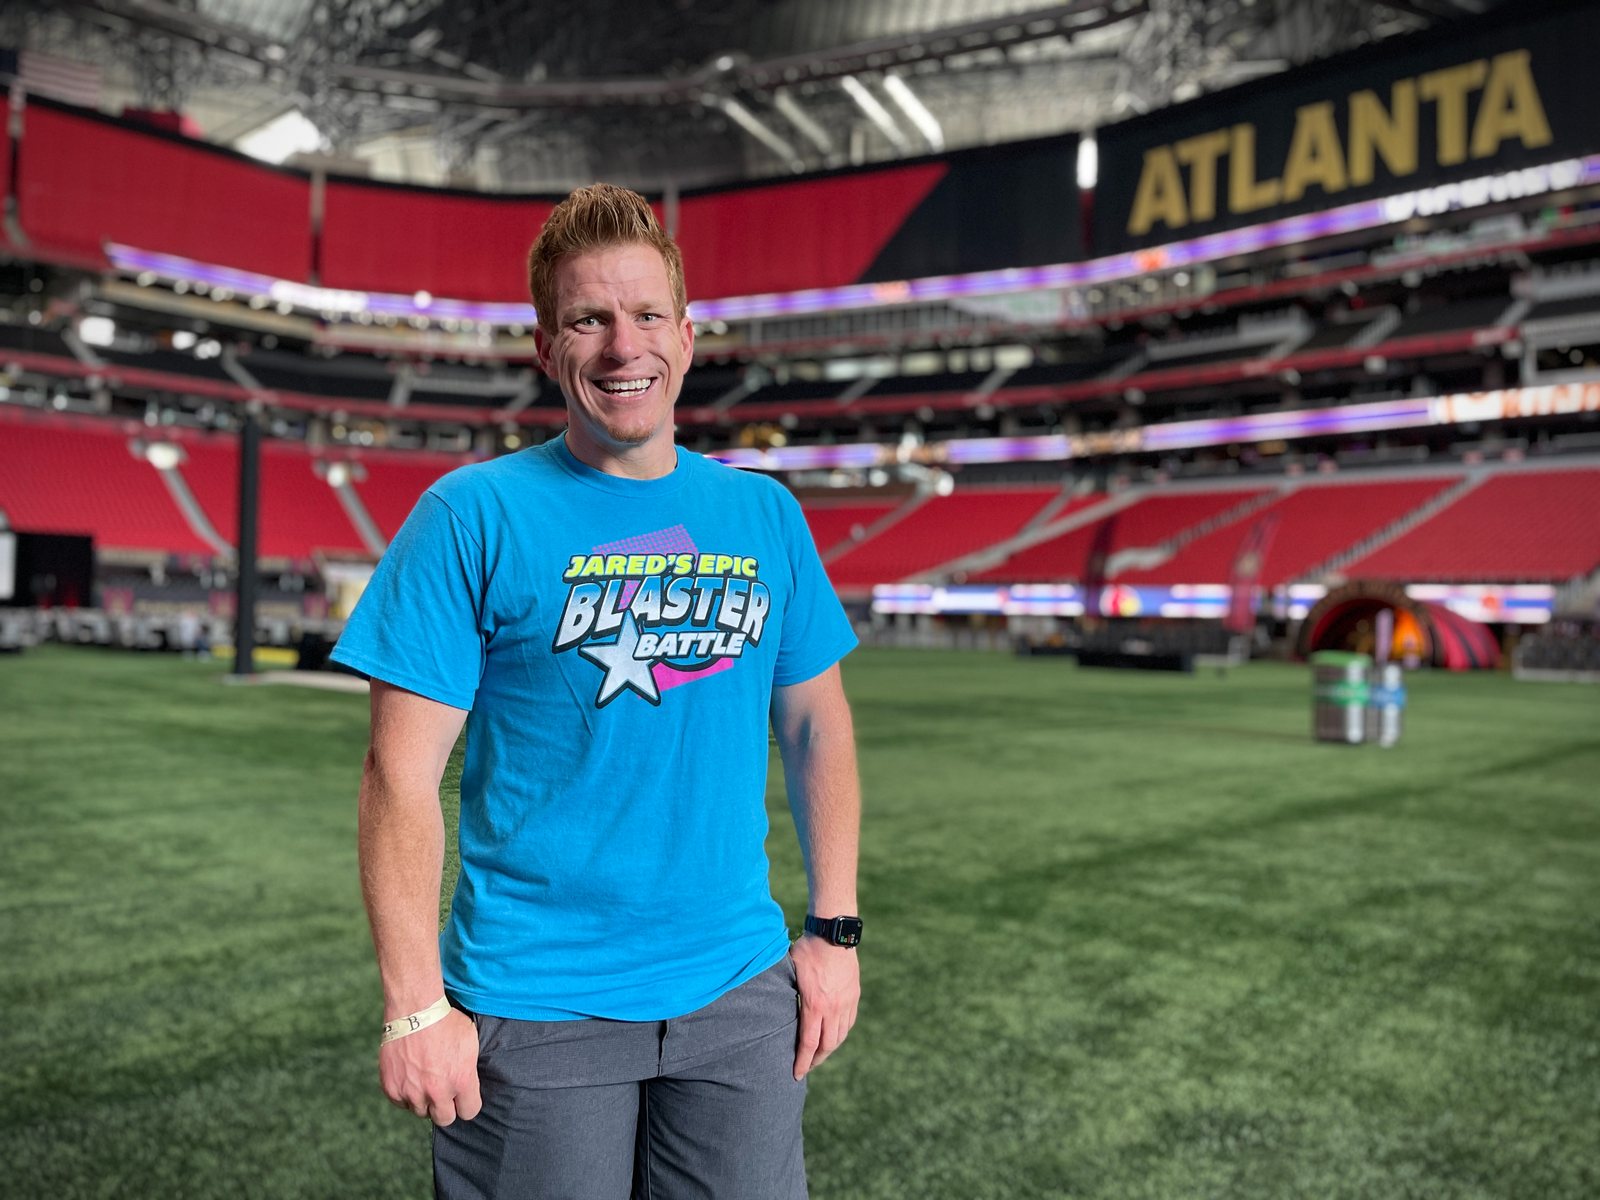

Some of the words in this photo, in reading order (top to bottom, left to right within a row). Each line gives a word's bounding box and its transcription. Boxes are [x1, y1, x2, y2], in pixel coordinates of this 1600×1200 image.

[1127, 49, 1553, 236] ATLANTA
[564, 554, 693, 580] JARED'S
[696, 554, 758, 578] EPIC
[554, 575, 770, 650] BLASTER
[633, 632, 747, 659] BATTLE
